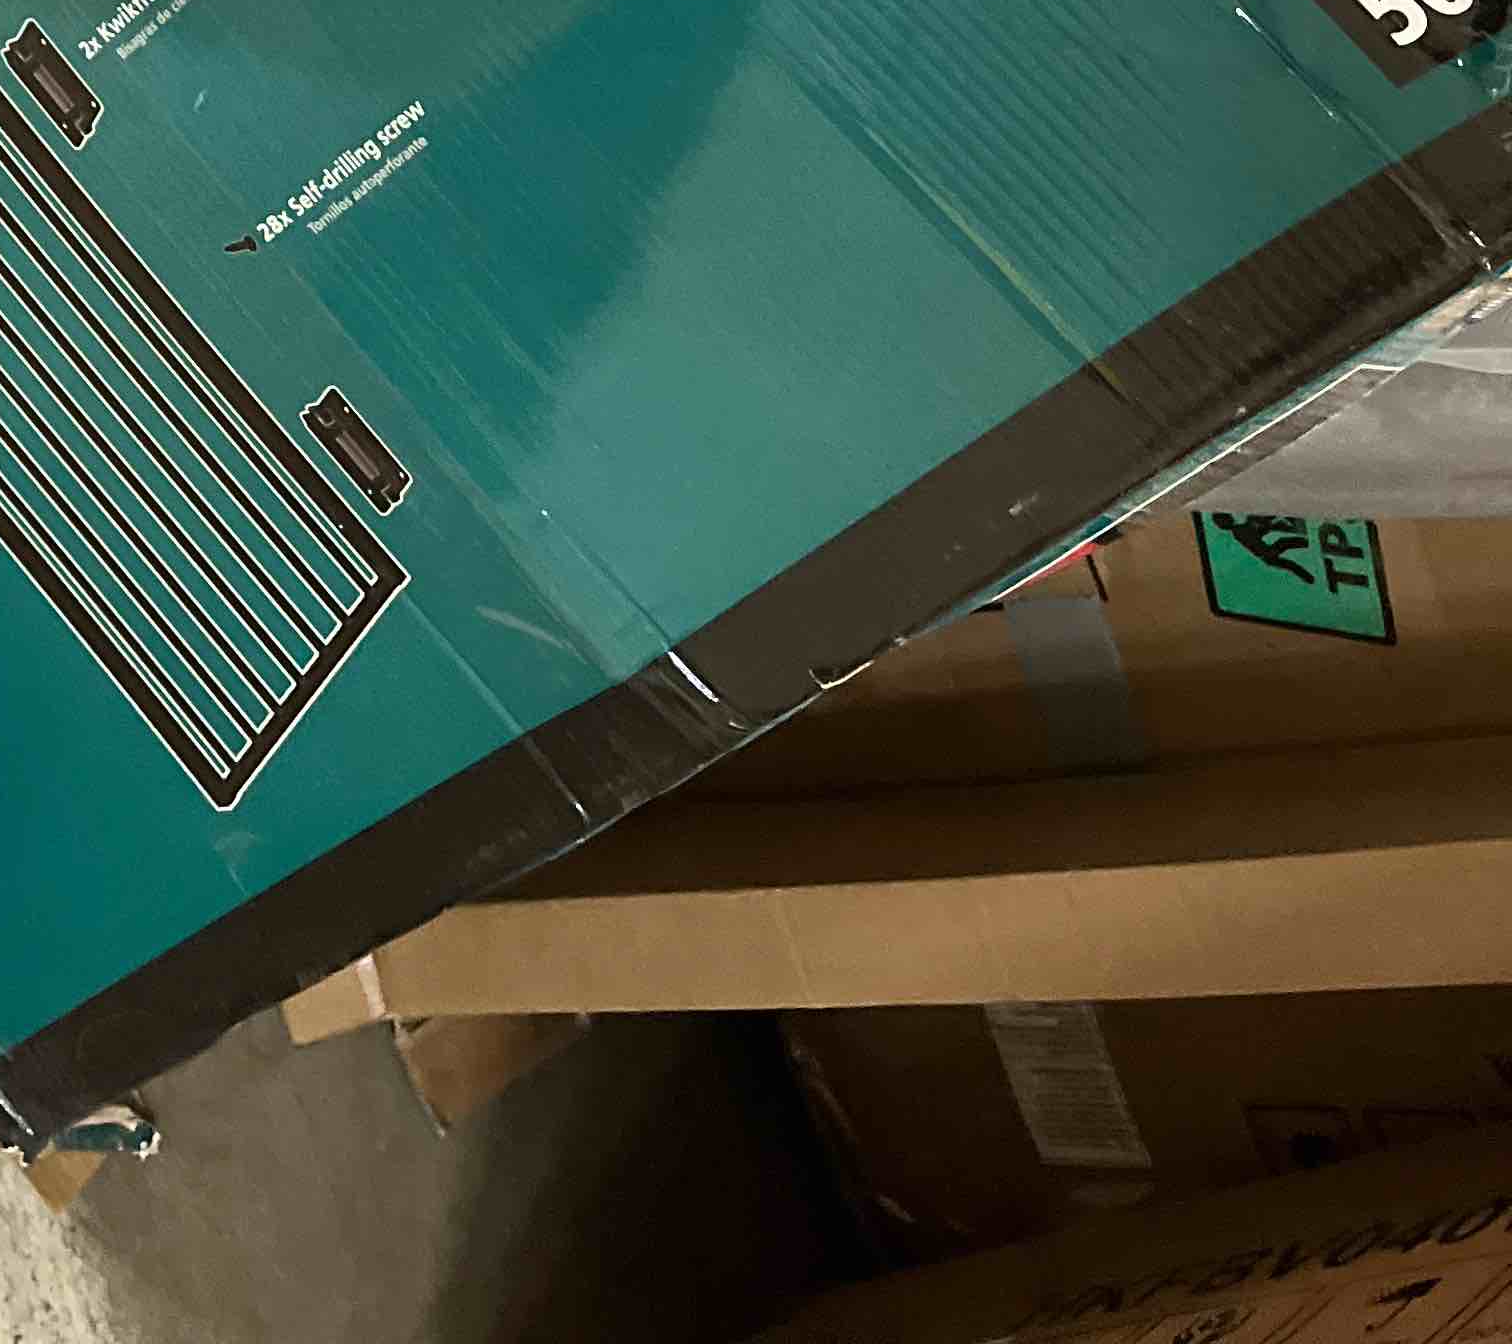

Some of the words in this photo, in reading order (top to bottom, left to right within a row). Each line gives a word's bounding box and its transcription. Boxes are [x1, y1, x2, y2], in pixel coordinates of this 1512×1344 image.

[77, 36, 103, 60] 2x
[256, 210, 293, 242] 28x
[287, 139, 381, 216] Self-drilling
[376, 100, 424, 146] screw
[306, 196, 353, 234] Tornillos
[351, 136, 428, 200] autoperforante
[1316, 520, 1369, 595] TP
